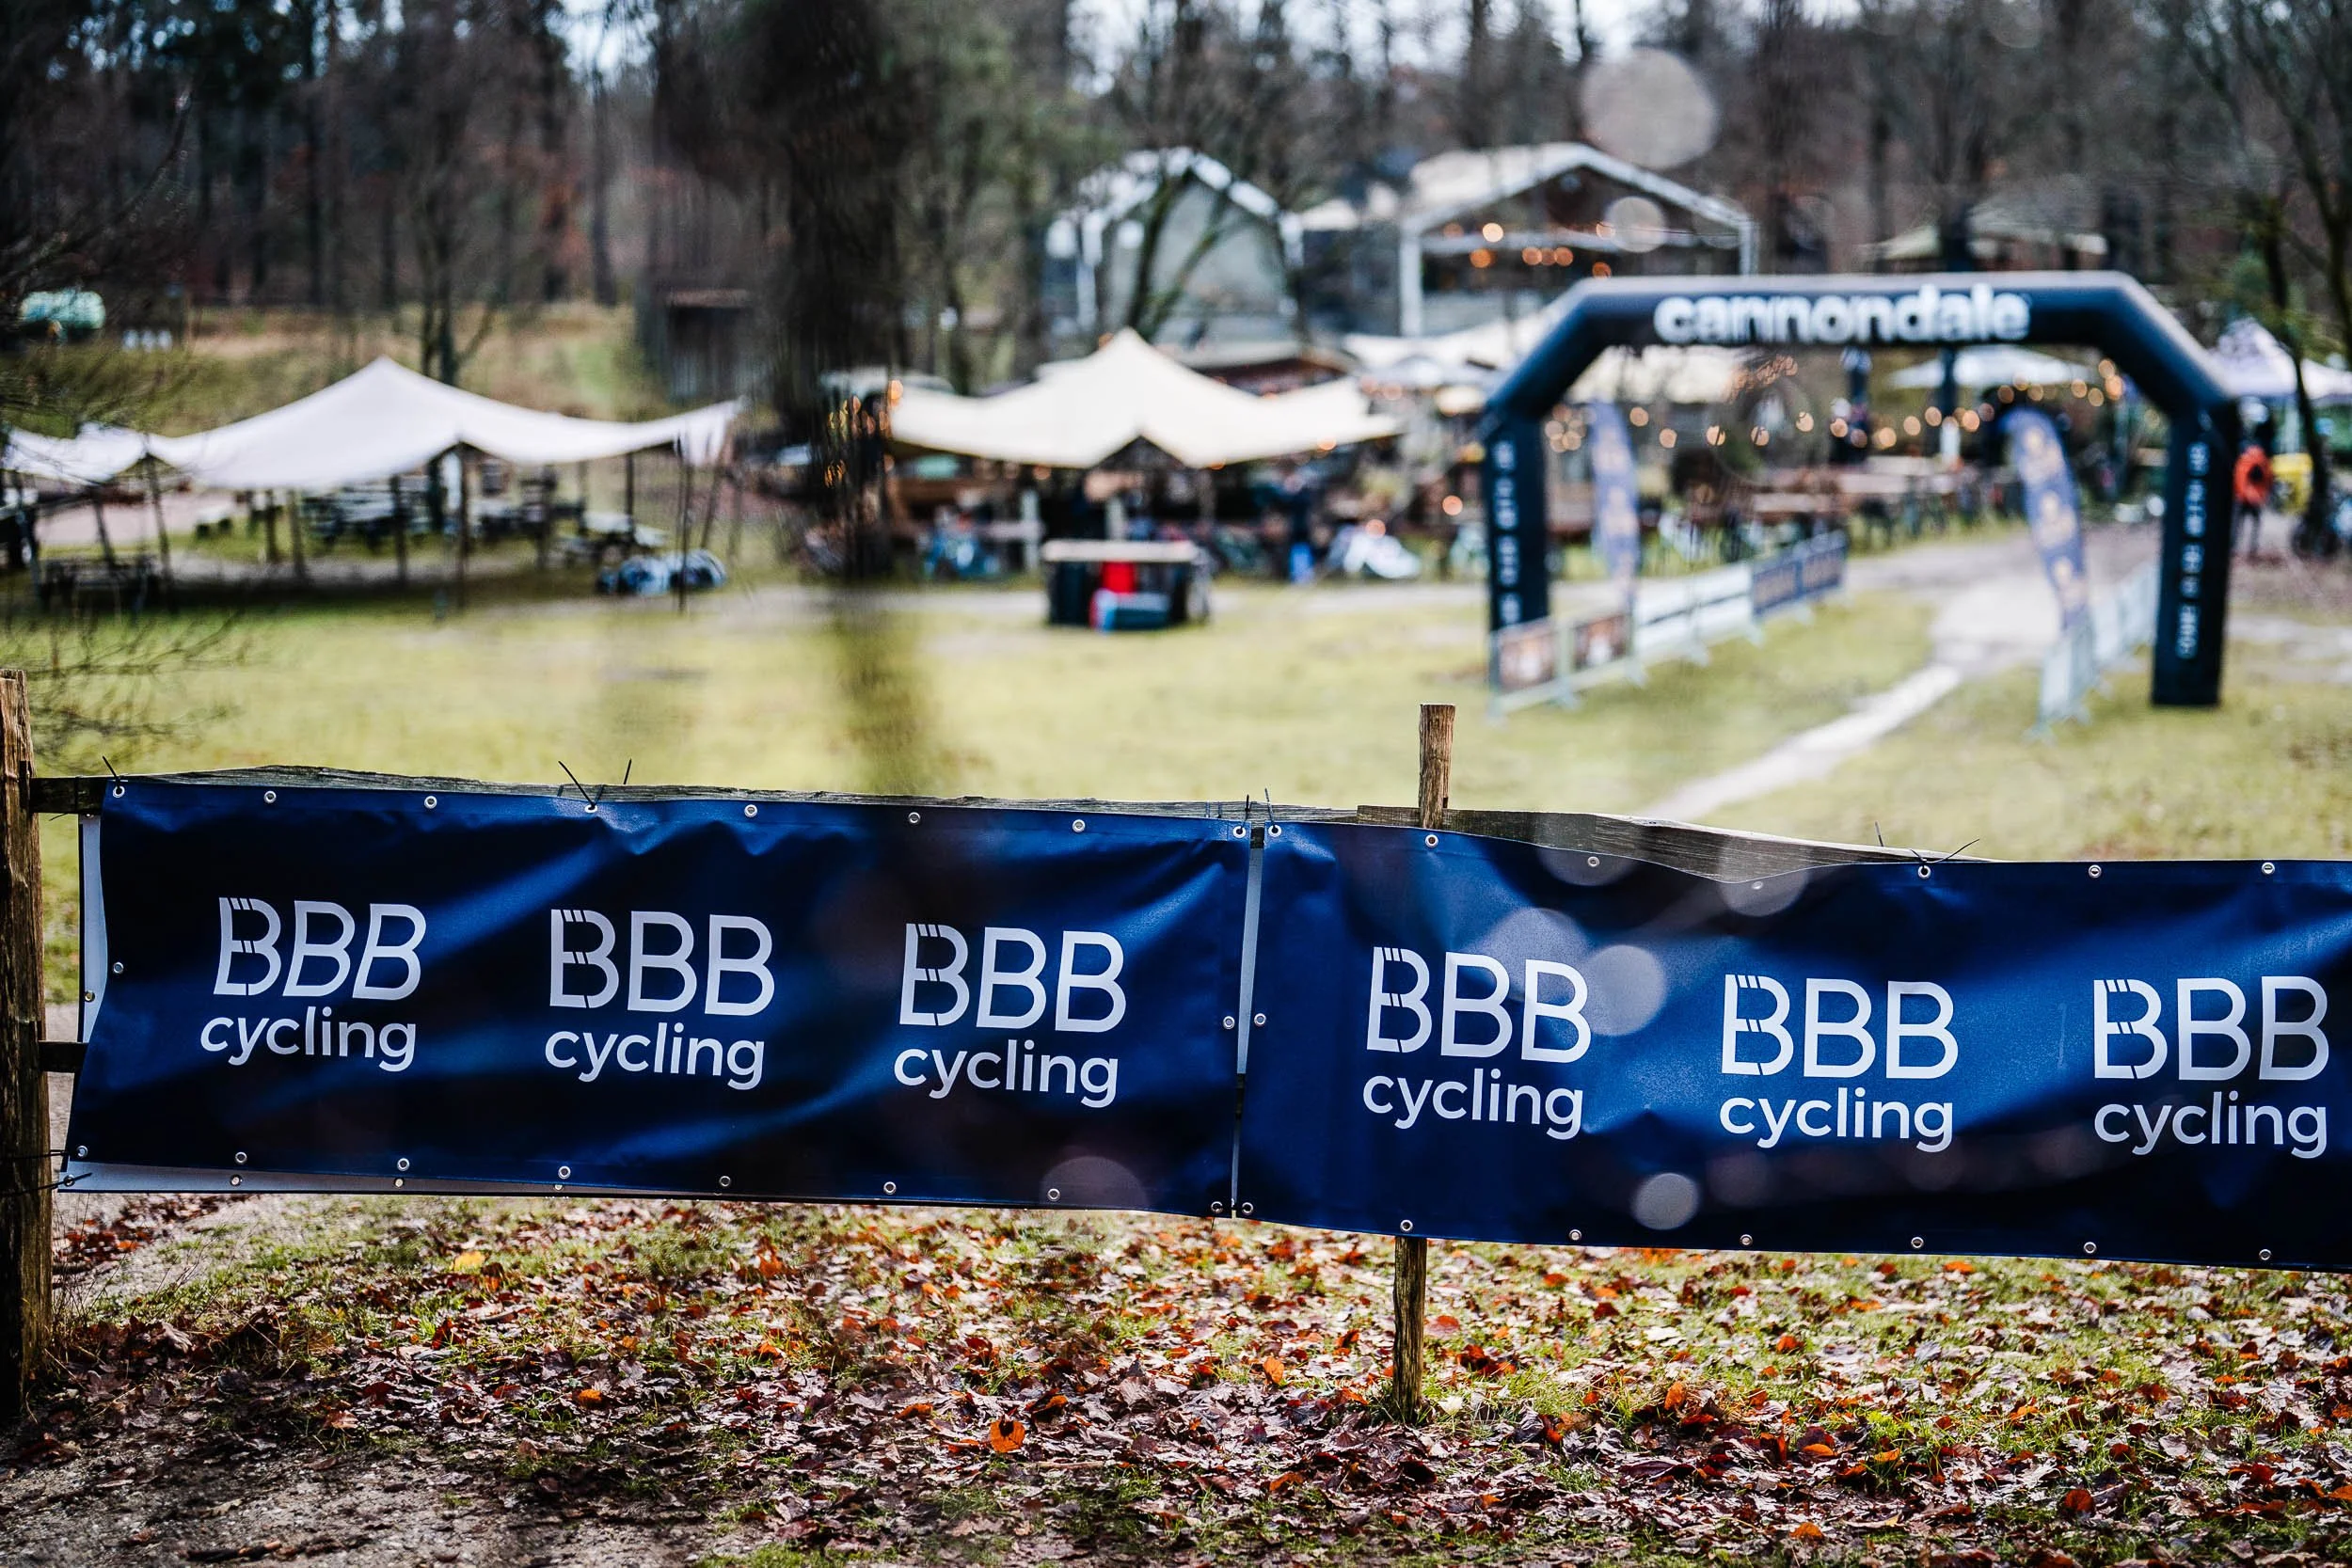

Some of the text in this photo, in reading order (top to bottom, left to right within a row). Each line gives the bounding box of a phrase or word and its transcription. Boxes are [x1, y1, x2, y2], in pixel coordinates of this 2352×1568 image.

[1653, 283, 2030, 344] cannondale
[214, 897, 427, 1001] BBB
[549, 909, 775, 1016] BBB
[898, 923, 1127, 1033] BBB
[200, 1006, 417, 1072] cycling
[1366, 946, 1592, 1064] BBB
[1721, 974, 1959, 1080] BBB
[2093, 975, 2329, 1081] BBB
[545, 1022, 766, 1091] cycling
[894, 1038, 1120, 1108] cycling
[1362, 1068, 1584, 1140] cycling
[1719, 1086, 1954, 1153] cycling
[2093, 1090, 2328, 1159] cycling
